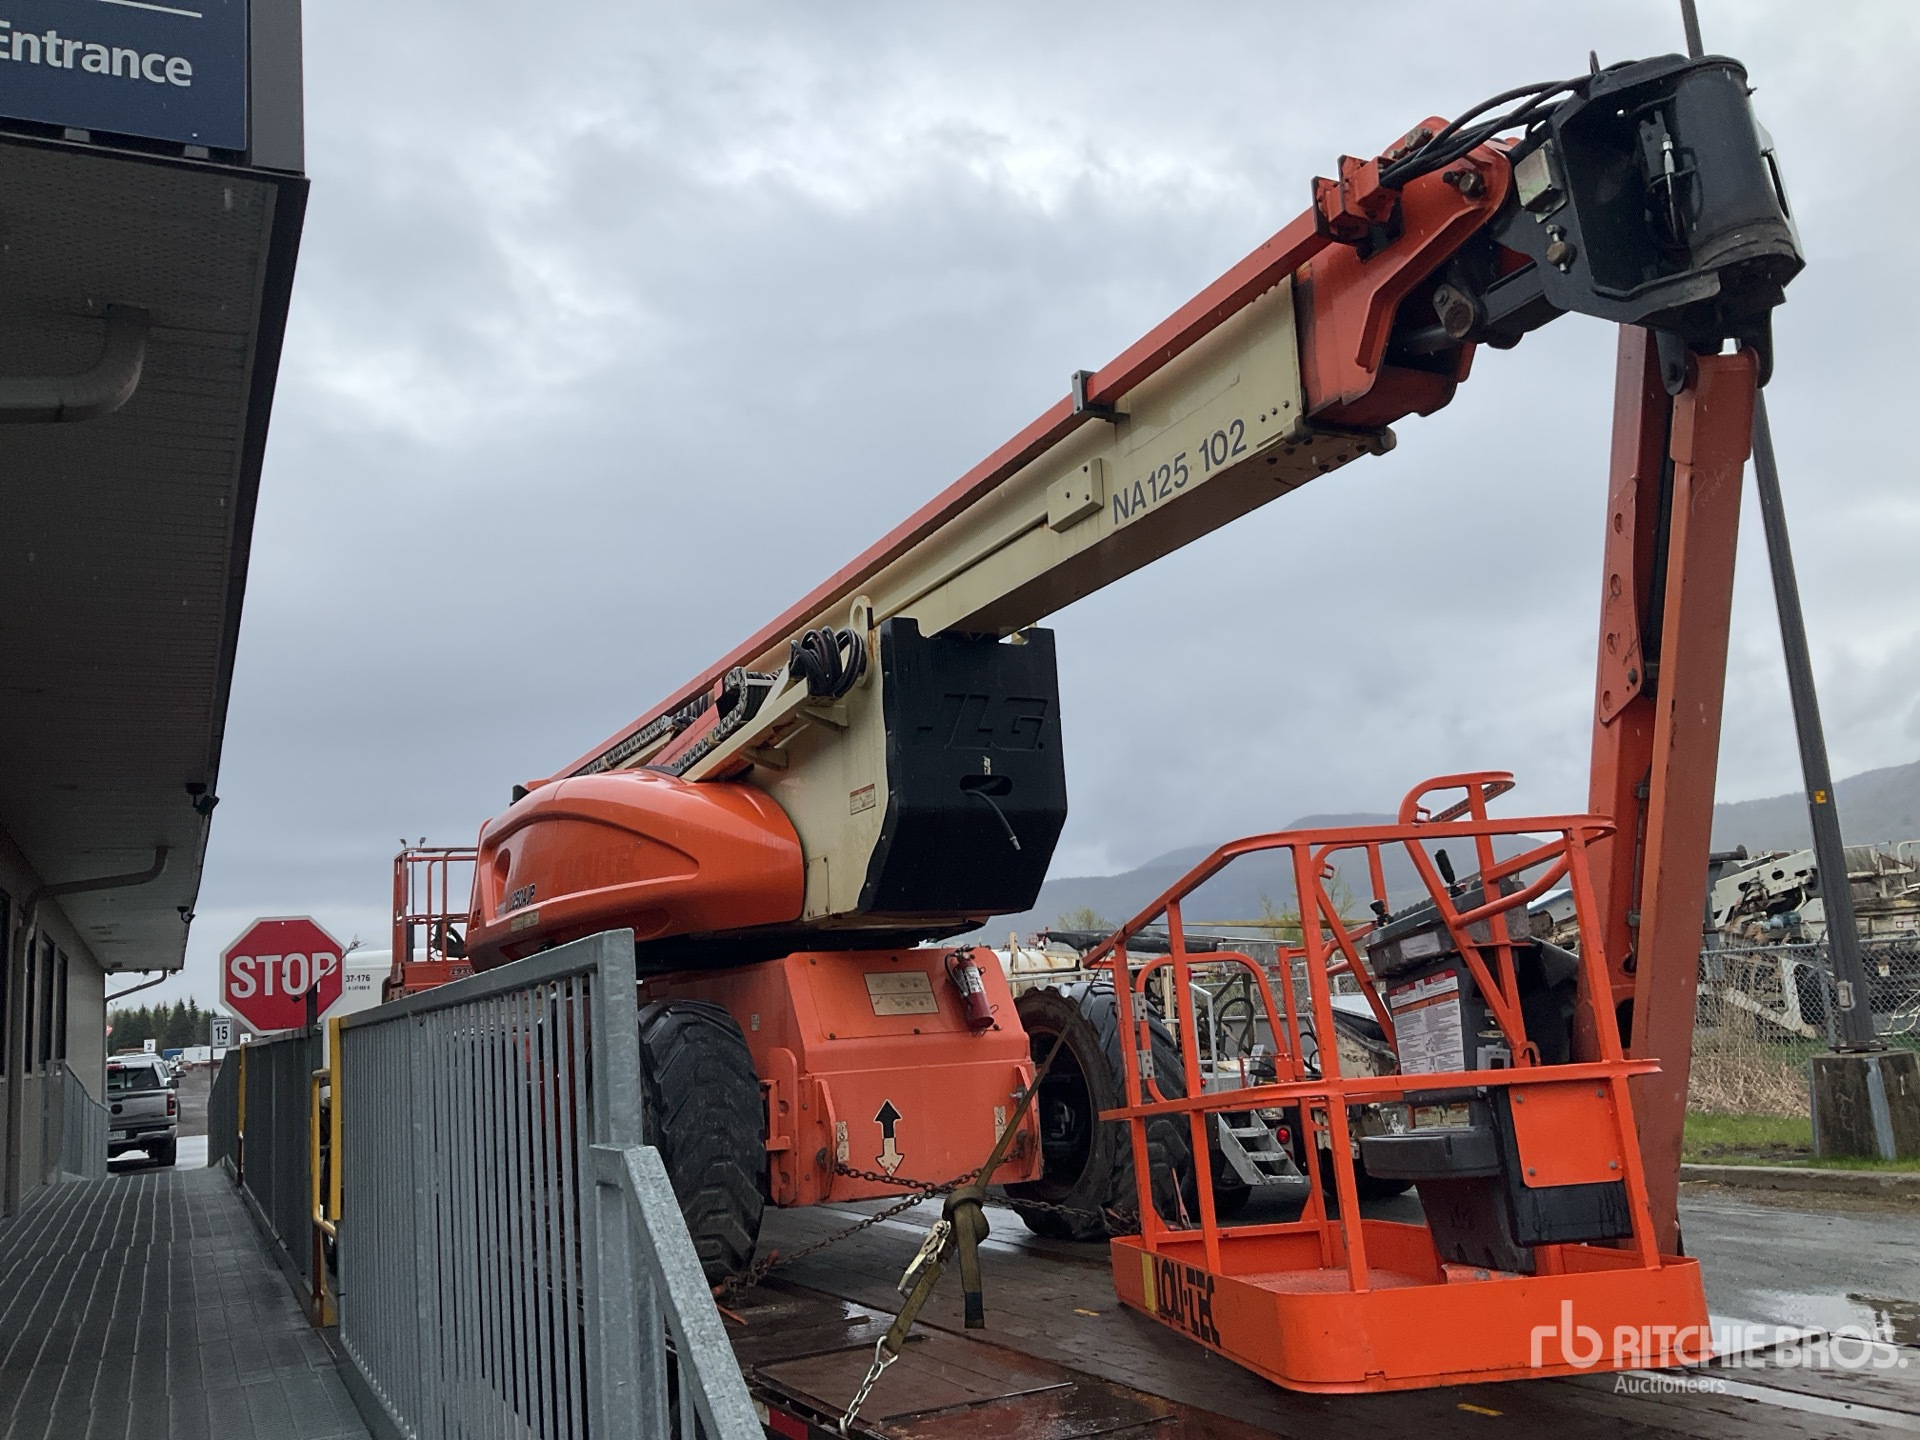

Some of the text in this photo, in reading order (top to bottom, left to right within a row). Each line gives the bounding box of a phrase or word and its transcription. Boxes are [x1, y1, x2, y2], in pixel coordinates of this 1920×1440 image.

[1112, 418, 1247, 525] NA125 102
[230, 951, 337, 998] STOP
[345, 974, 371, 982] 37-176
[215, 1025, 228, 1040] 15
